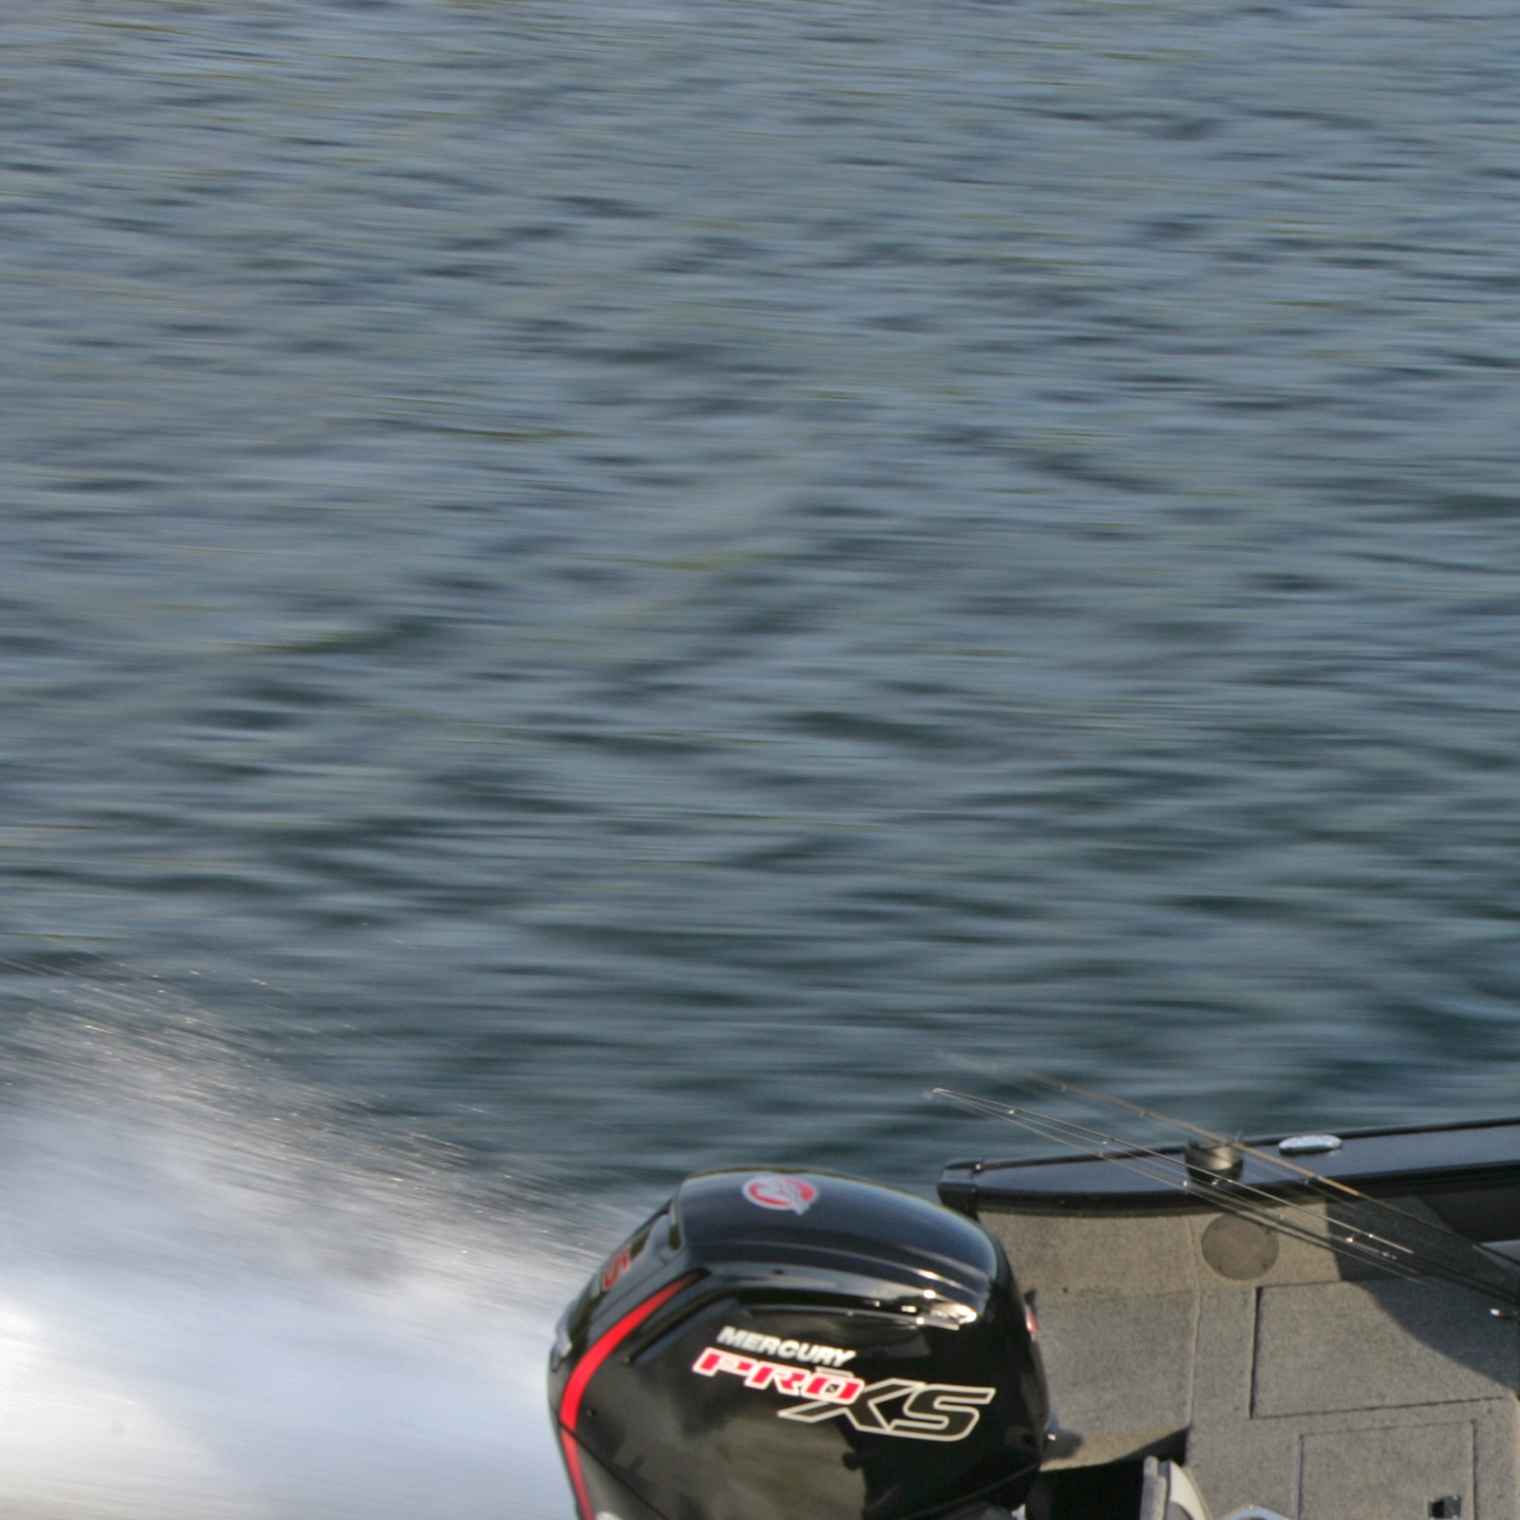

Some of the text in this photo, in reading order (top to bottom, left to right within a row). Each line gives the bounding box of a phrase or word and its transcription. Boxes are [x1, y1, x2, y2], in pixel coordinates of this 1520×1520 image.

[716, 1325, 857, 1368] MERCURY
[692, 1347, 997, 1443] PRO XS
